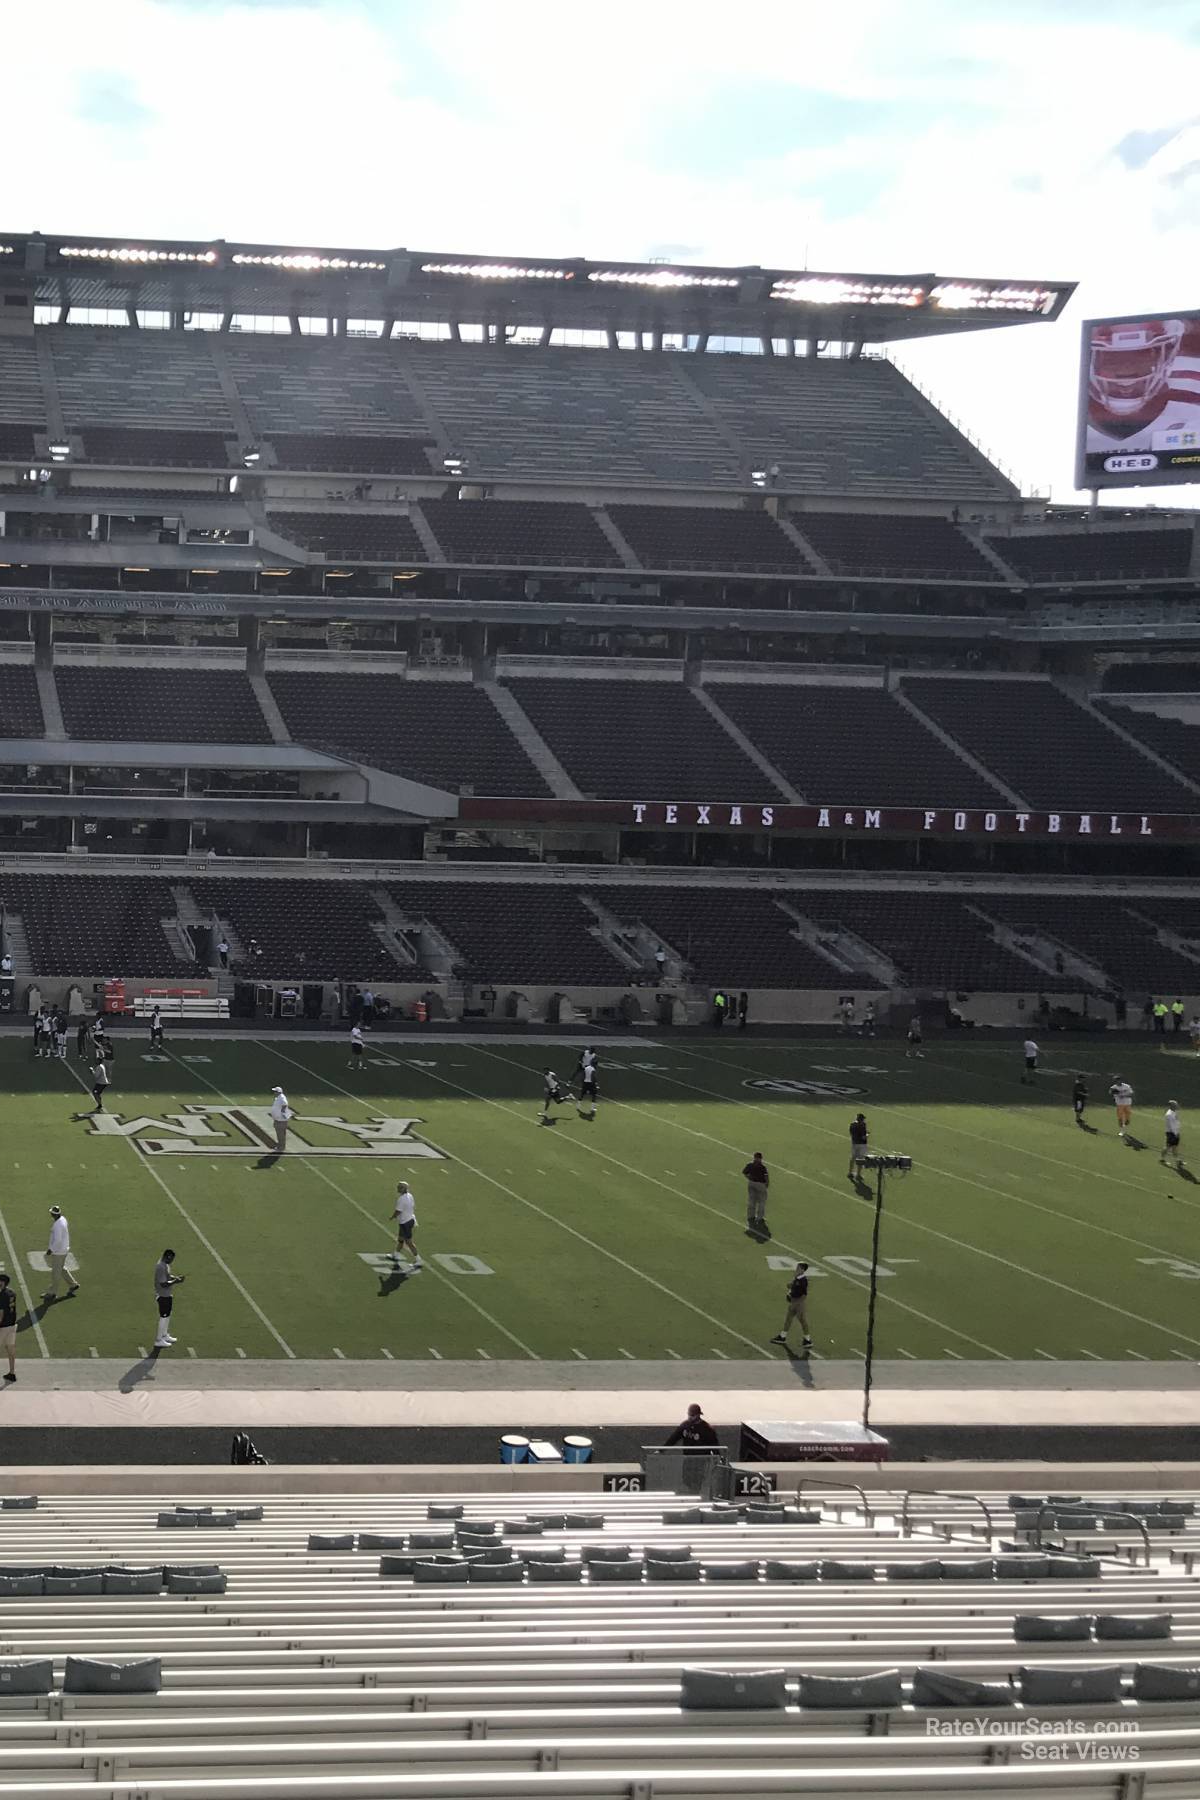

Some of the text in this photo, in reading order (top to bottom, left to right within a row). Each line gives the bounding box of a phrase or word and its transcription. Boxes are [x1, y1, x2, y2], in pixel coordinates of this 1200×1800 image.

[40, 597, 70, 607] TO
[633, 805, 1152, 836] TEXAS A&M FOOTBALL
[357, 1252, 496, 1275] 50
[608, 1477, 640, 1492] 126
[739, 1476, 773, 1494] 125
